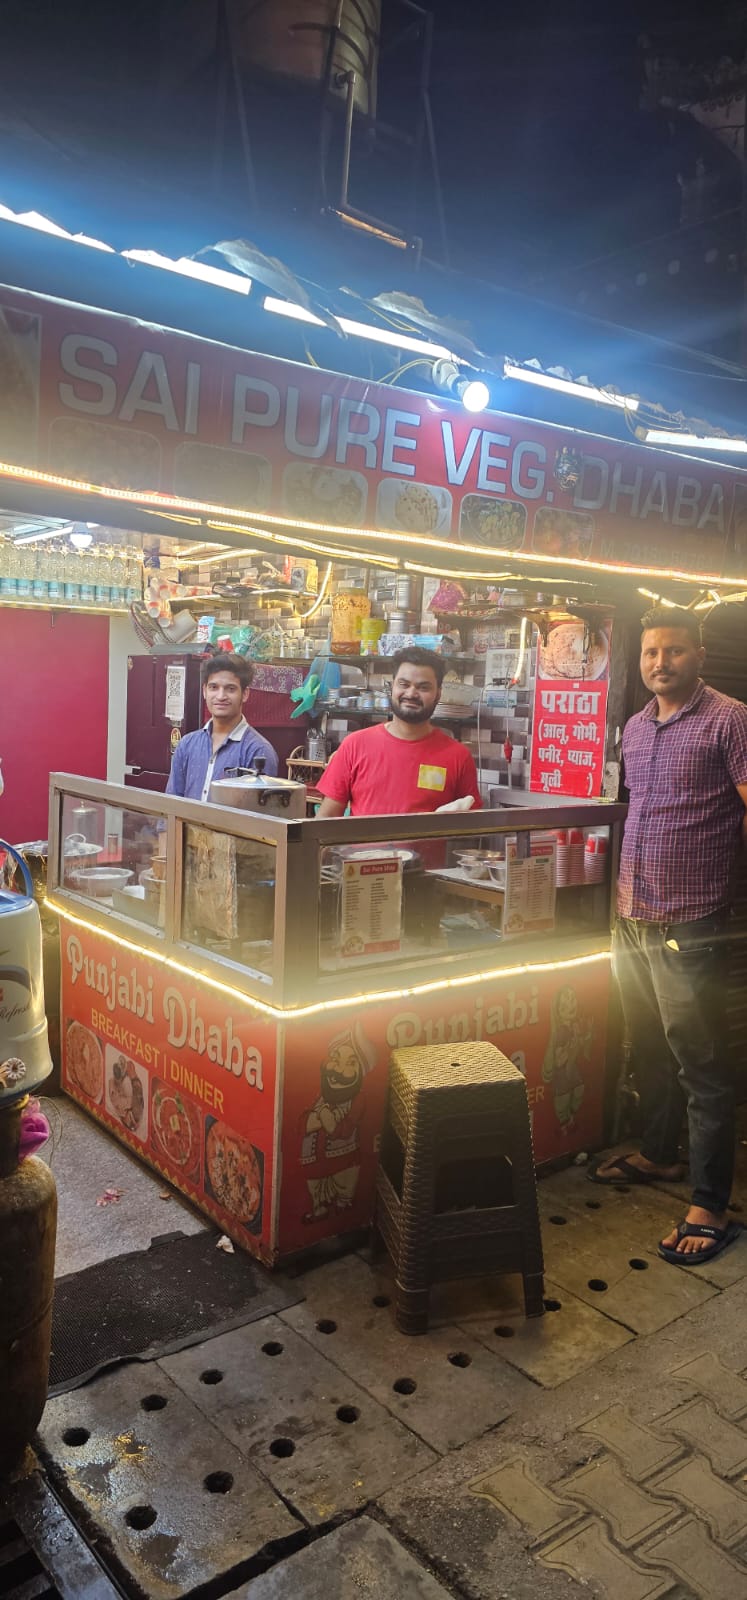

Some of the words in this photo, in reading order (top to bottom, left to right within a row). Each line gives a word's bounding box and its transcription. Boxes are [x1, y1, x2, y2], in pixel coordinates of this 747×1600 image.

[58, 332, 201, 436] SAI
[230, 373, 421, 477] PURE
[440, 419, 555, 503] VEG.
[573, 453, 724, 534] DHABA
[540, 682, 601, 716] परांठा
[538, 718, 569, 745] (आलू,
[538, 743, 564, 767] पनीर,
[567, 749, 596, 770] प्याज,
[540, 768, 561, 792] मूली
[66, 934, 154, 1024] Punjabi
[162, 986, 264, 1091] Dhaba
[91, 1007, 160, 1070] BREAKFAST
[170, 1059, 225, 1115] DINNER
